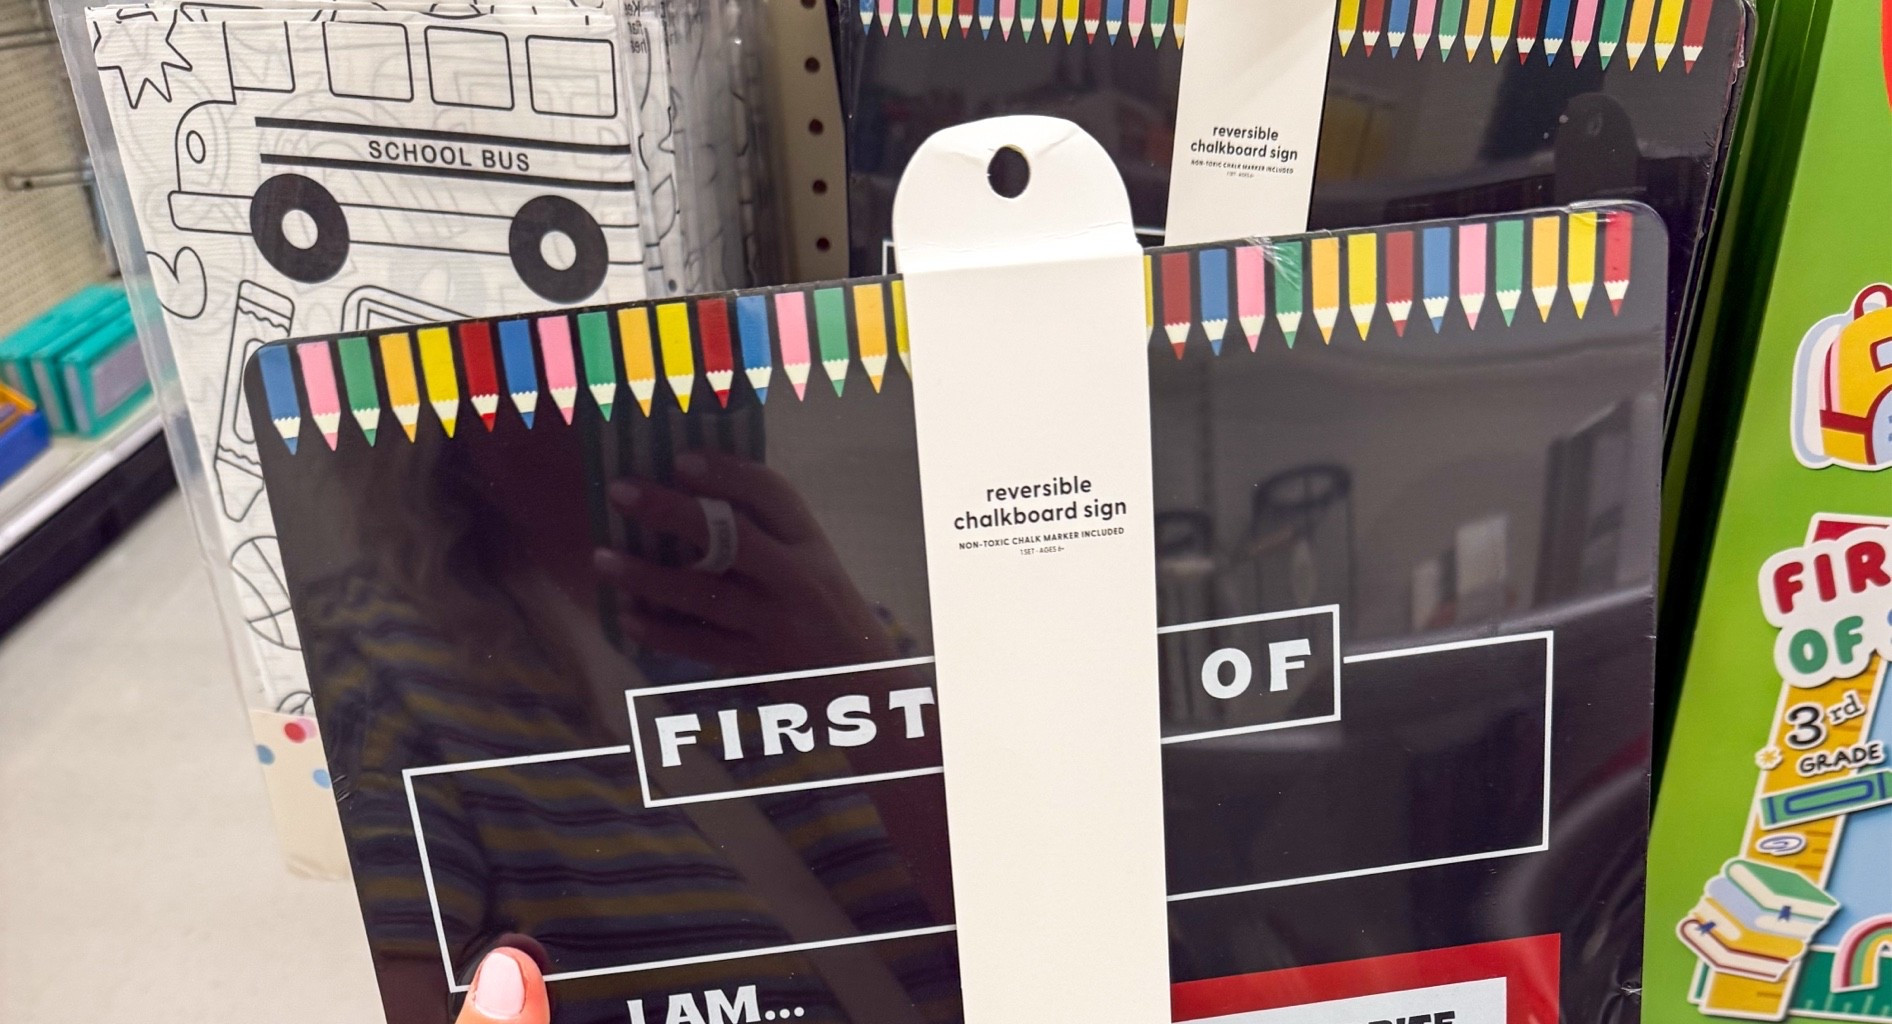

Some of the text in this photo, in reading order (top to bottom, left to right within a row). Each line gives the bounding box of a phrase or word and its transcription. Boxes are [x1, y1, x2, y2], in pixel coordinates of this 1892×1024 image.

[1212, 126, 1279, 141] reversible
[368, 140, 530, 172] SCHOOL BUS
[1190, 139, 1298, 163] chalkboard sign
[986, 475, 1092, 502] reversible
[954, 498, 1127, 530] chalkboard sign
[959, 527, 1125, 550] NON-TOXIC CHALK MARKER INCLUDED
[1788, 615, 1864, 674] OF
[655, 638, 1311, 767] FIRST OF
[1799, 744, 1882, 774] GRADE
